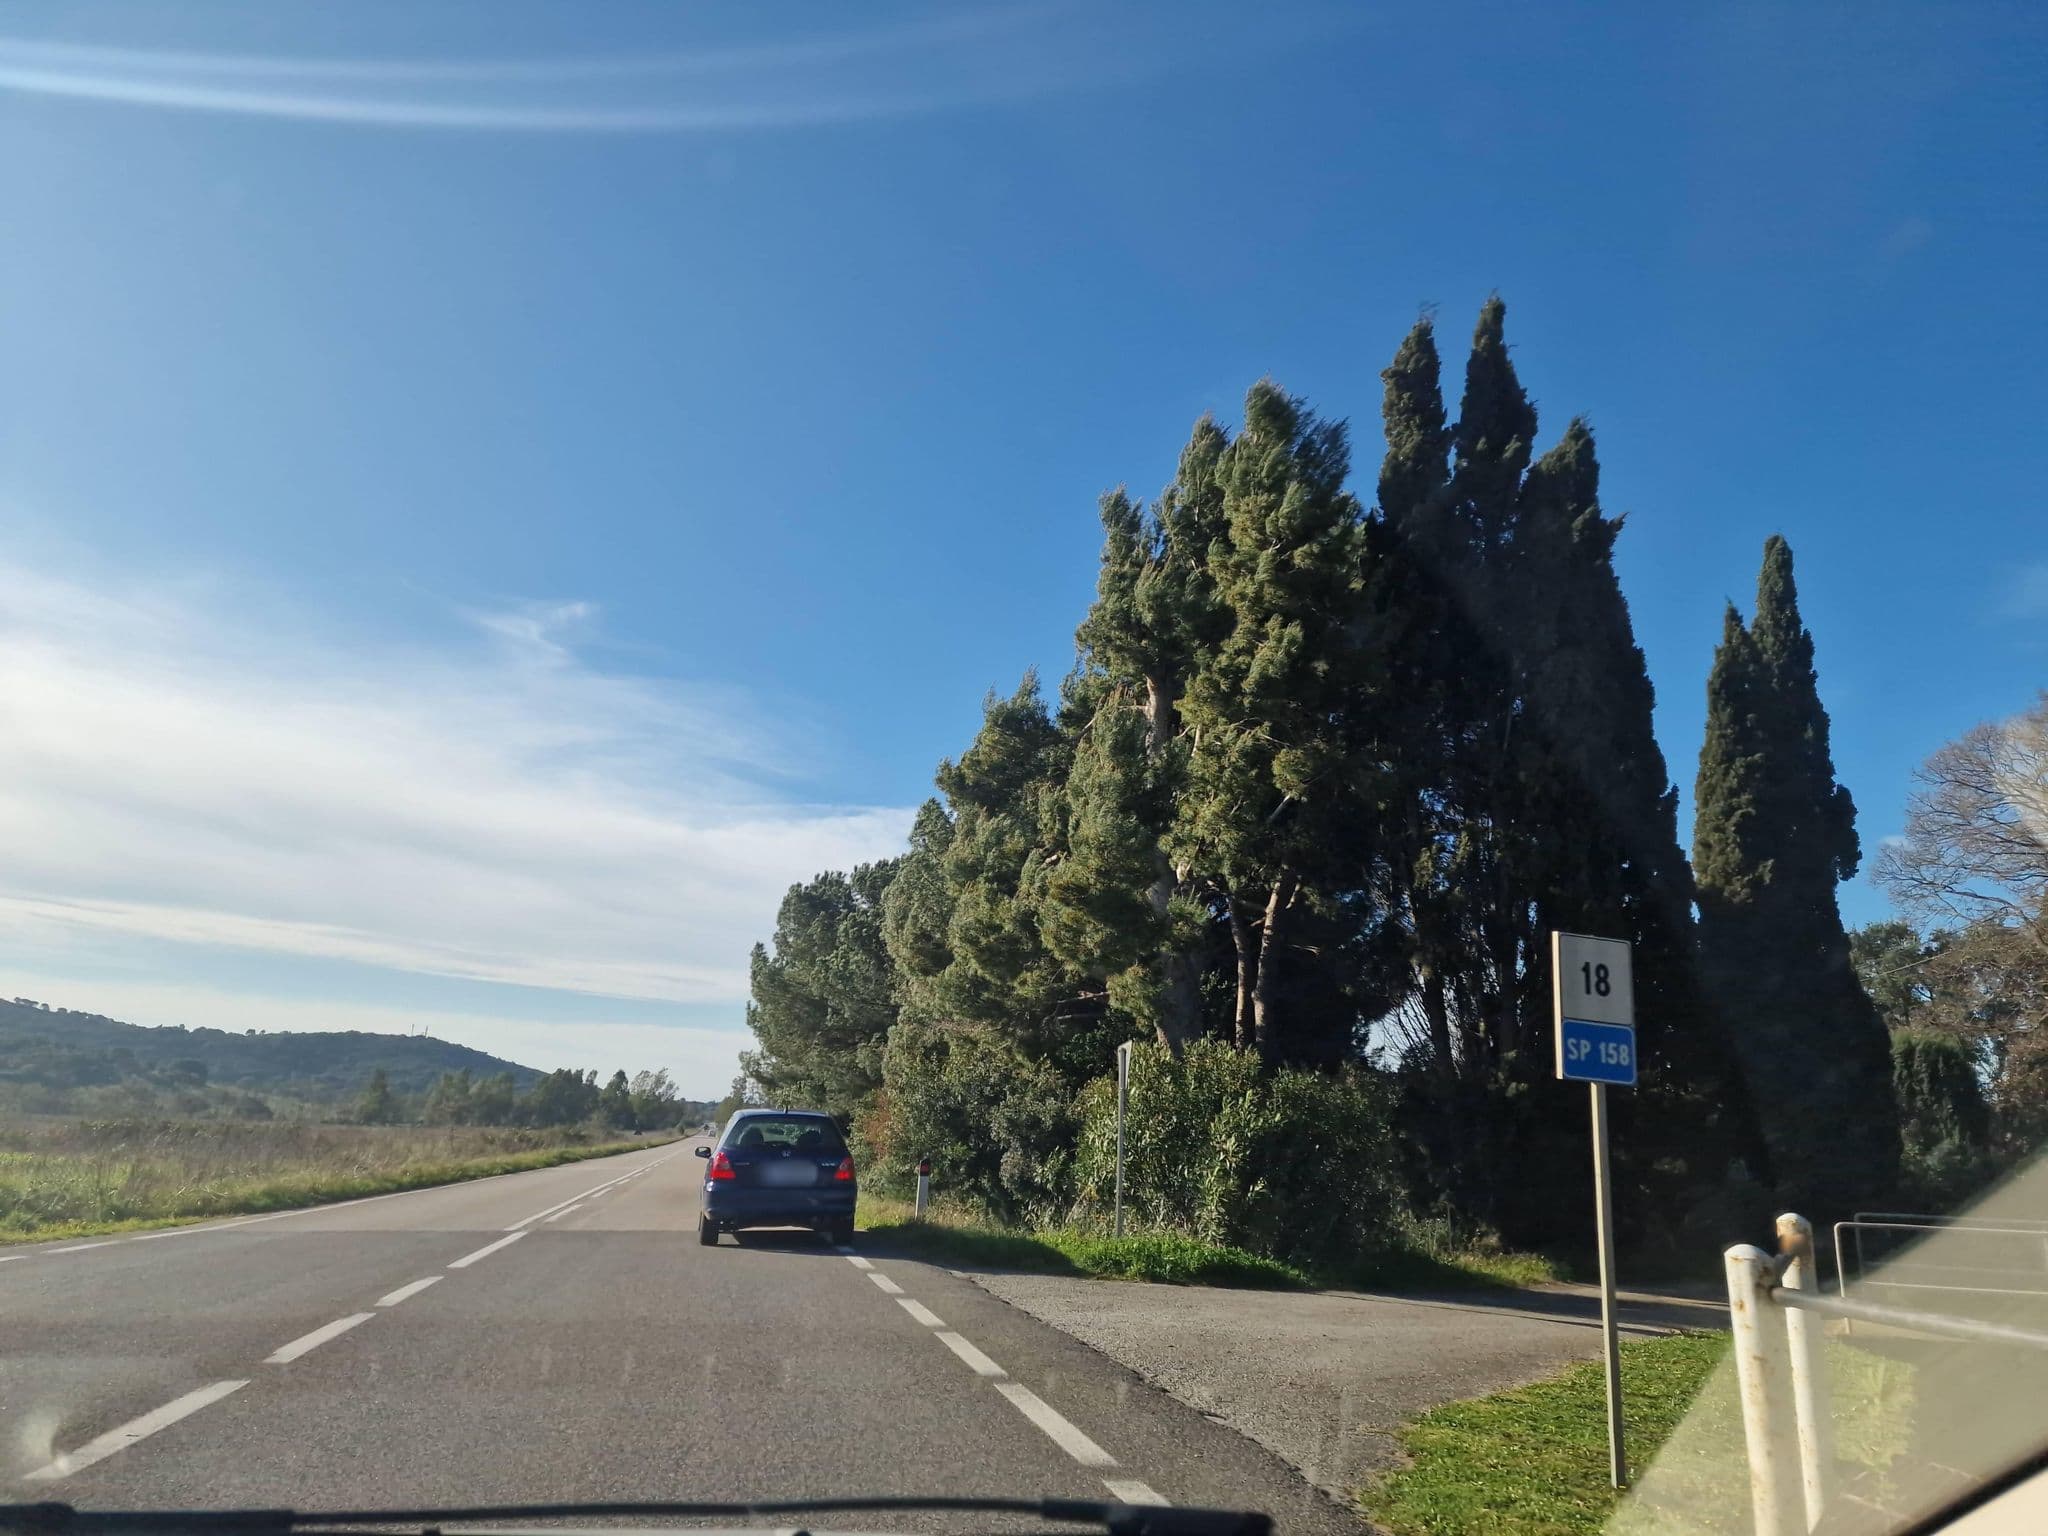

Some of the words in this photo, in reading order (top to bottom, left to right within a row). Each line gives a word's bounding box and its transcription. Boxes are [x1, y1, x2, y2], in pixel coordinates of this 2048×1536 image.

[1582, 962, 1611, 997] 18
[1567, 1038, 1591, 1062] SP
[1598, 1041, 1630, 1067] 158
